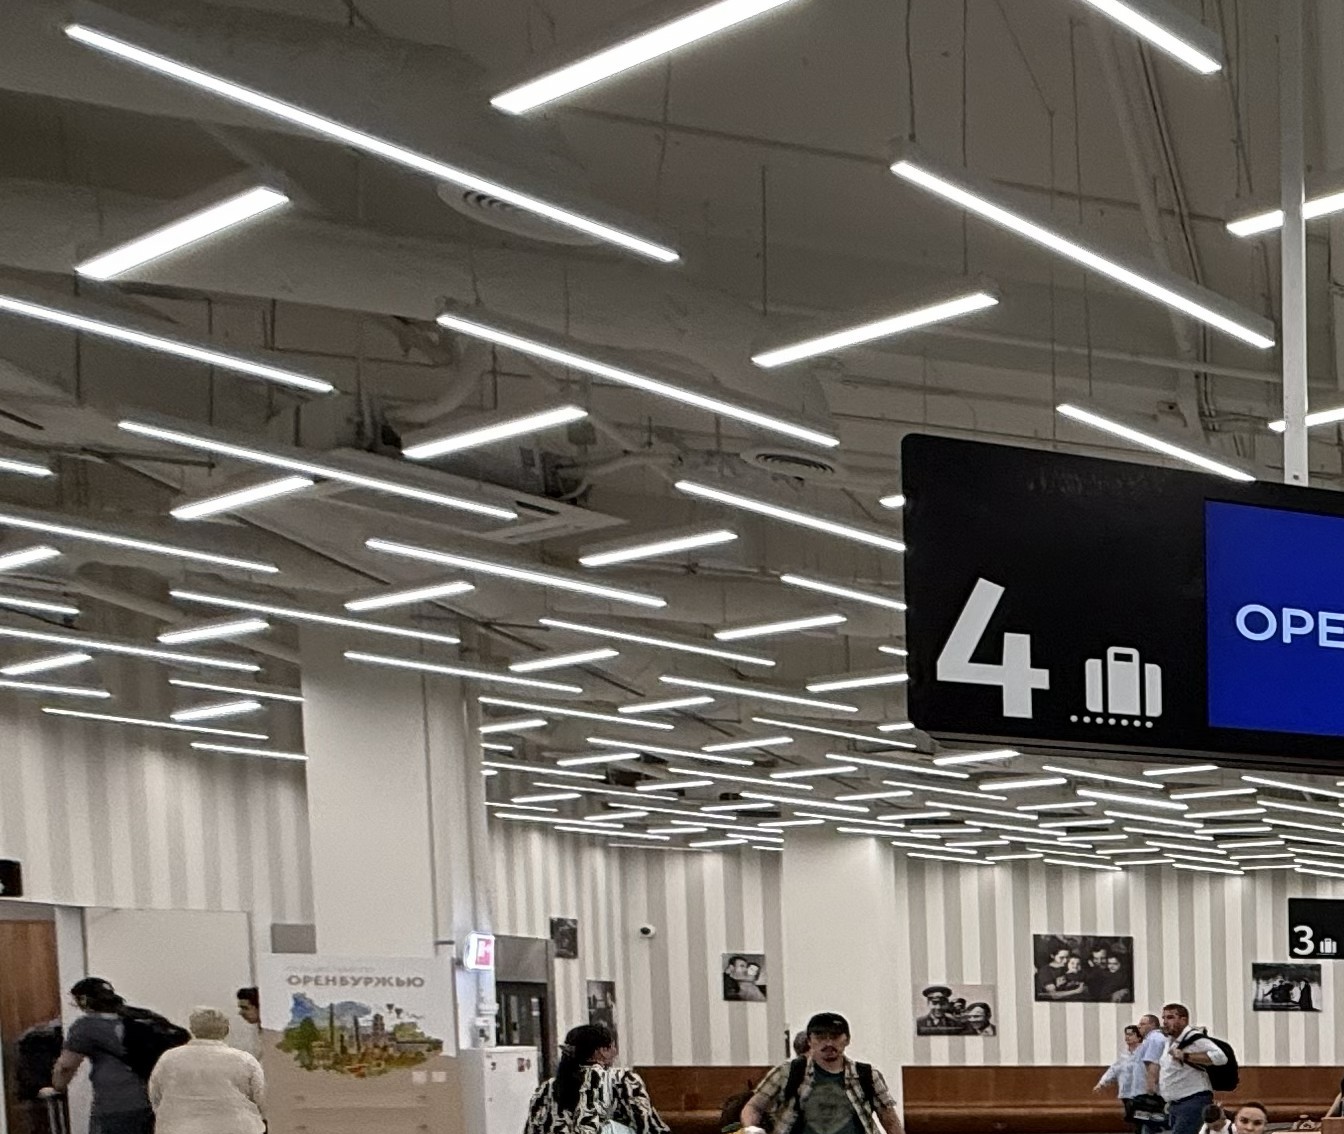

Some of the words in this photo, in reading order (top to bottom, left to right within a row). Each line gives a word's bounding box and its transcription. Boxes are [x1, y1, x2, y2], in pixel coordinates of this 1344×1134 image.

[936, 577, 1050, 719] 4
[1292, 925, 1315, 956] 3
[287, 974, 425, 988] ОРЕНБУРЖЬЮ
